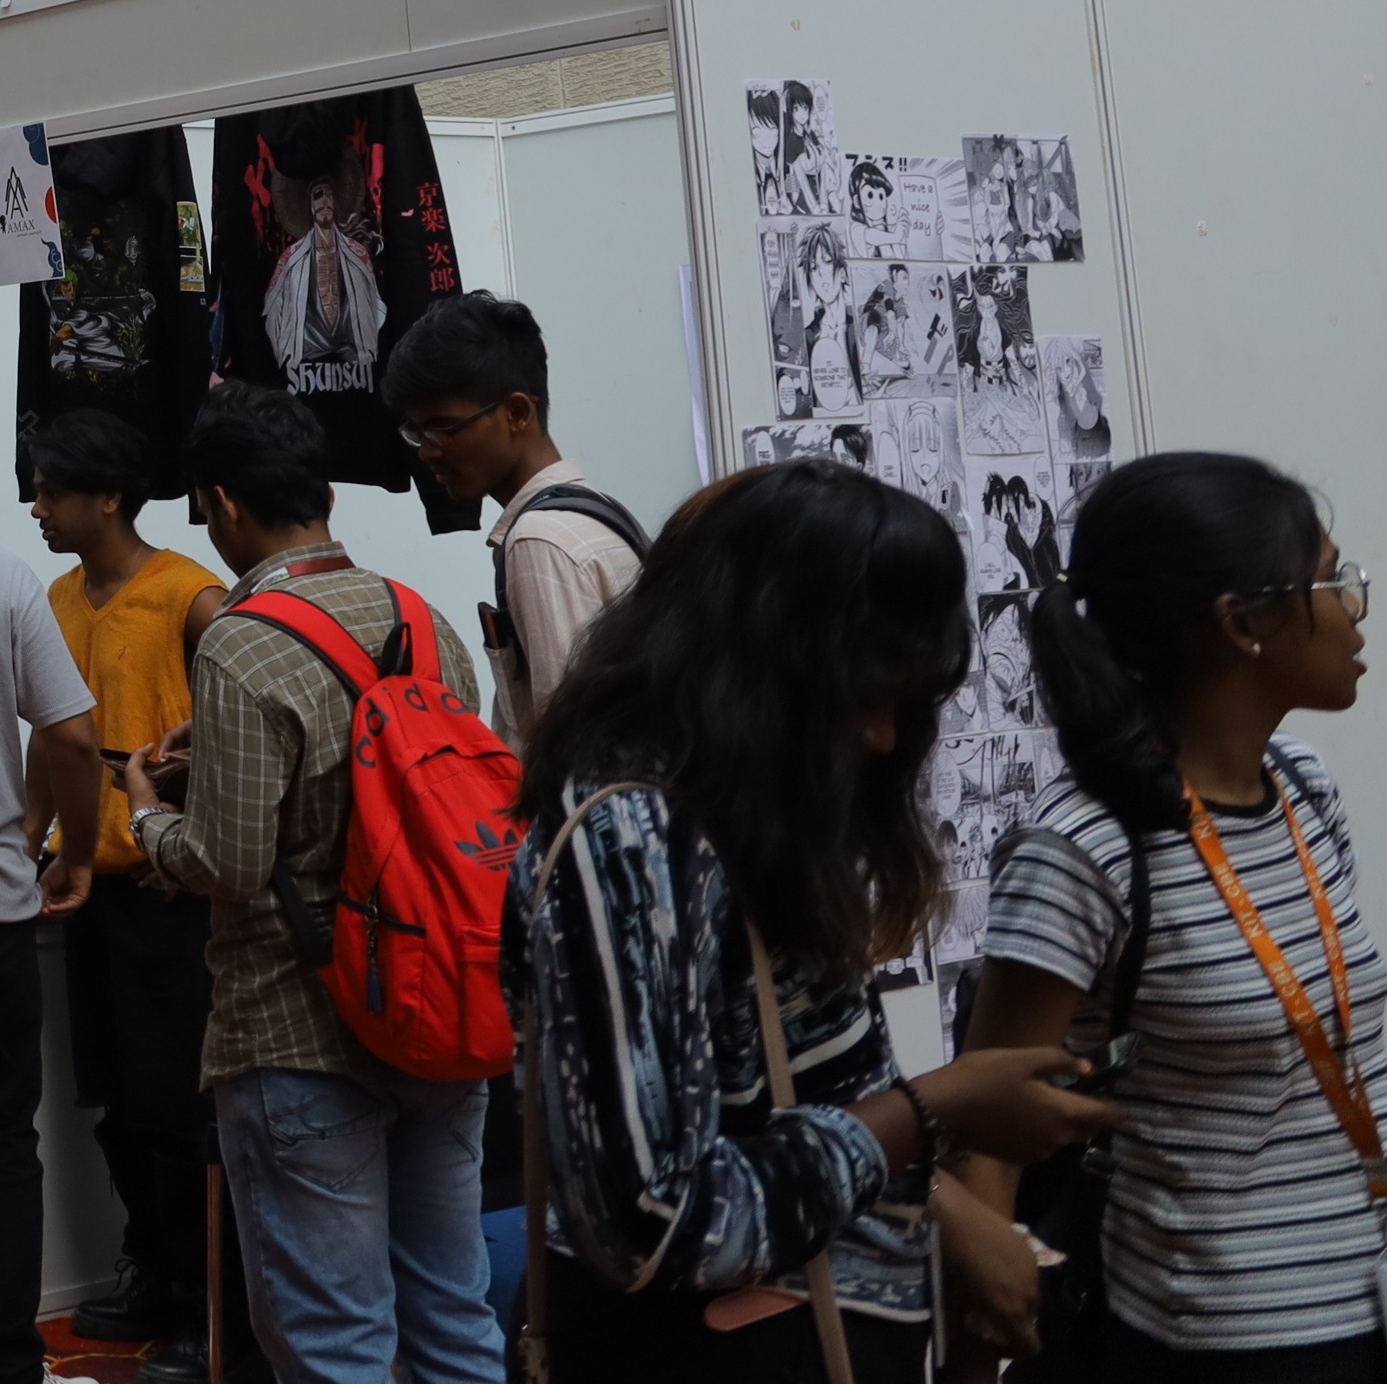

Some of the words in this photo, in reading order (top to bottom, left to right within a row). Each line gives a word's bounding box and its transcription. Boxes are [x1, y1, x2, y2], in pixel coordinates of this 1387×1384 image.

[903, 183, 926, 193] Have
[911, 200, 930, 212] nice
[913, 220, 931, 236] day
